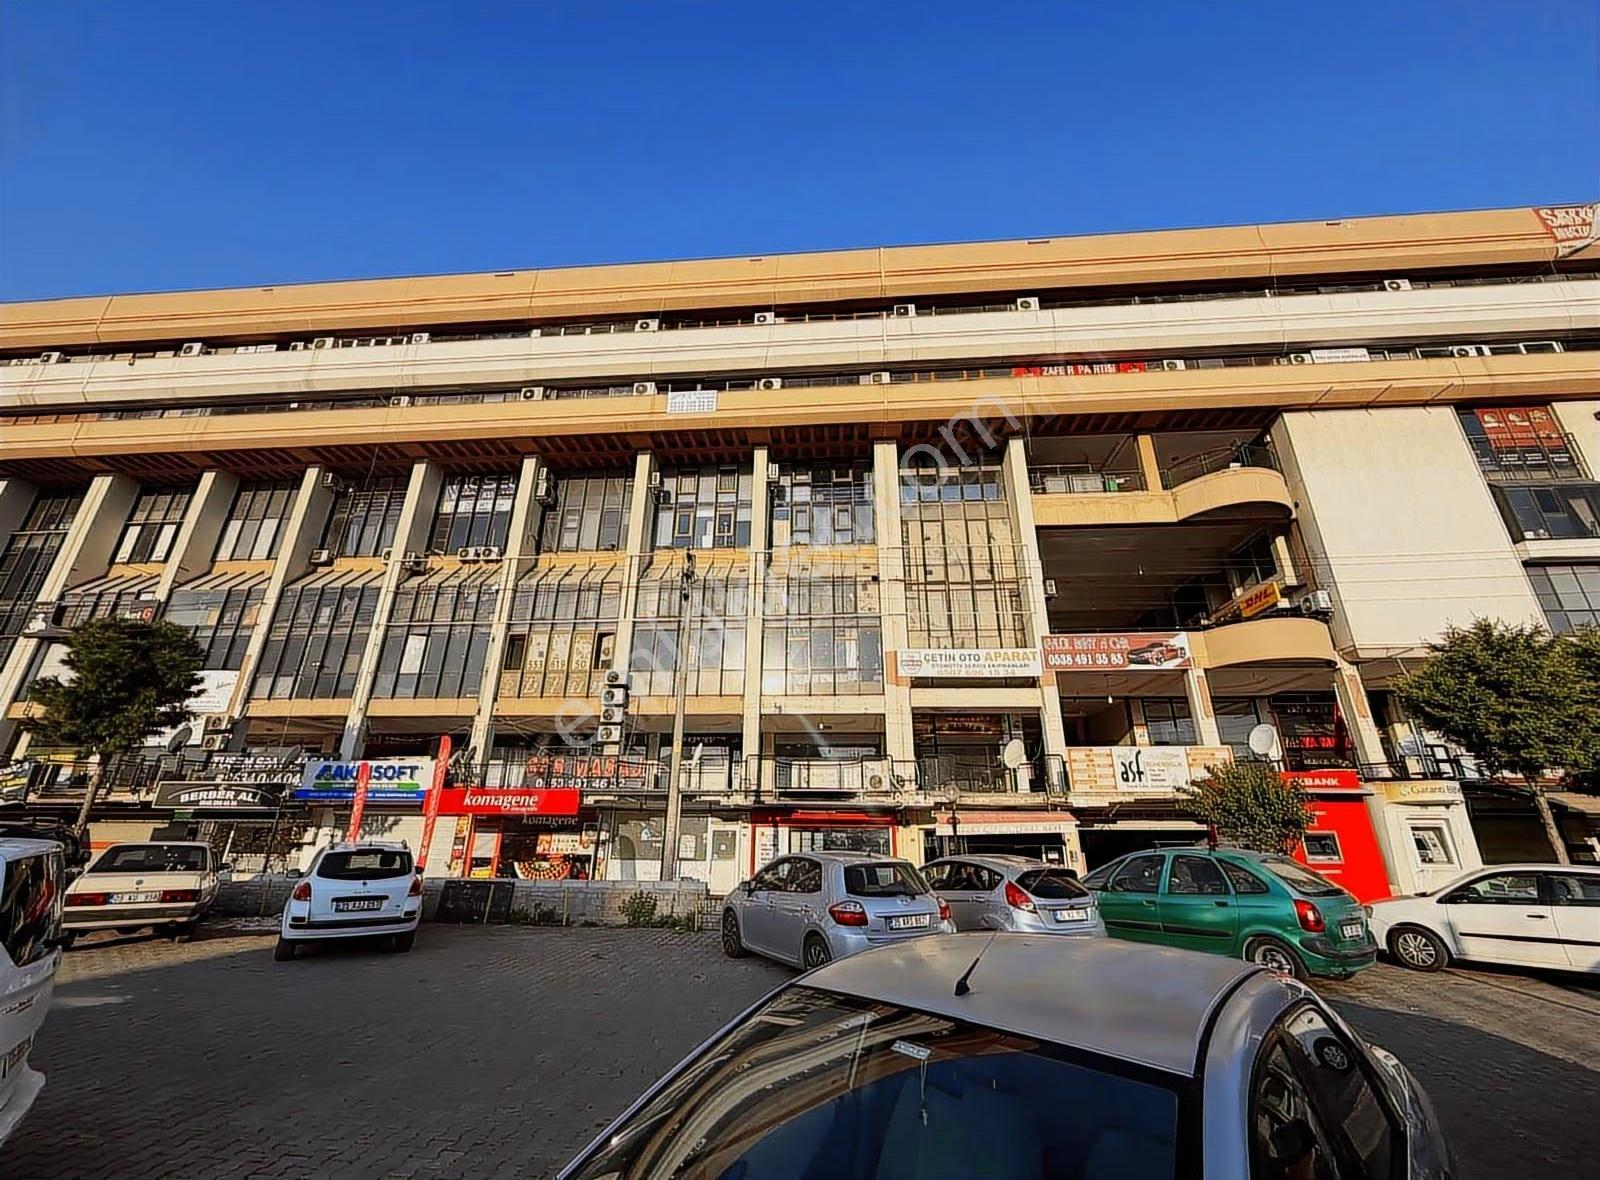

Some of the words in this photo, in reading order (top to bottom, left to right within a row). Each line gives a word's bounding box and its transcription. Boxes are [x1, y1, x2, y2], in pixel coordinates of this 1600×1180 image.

[1042, 366, 1074, 377] ZAFER
[923, 651, 956, 663] ÇETİN
[959, 653, 981, 662] OTO
[984, 651, 1038, 661] APARAT
[332, 764, 420, 780] AKSOFT
[1410, 784, 1446, 794] Garanti
[180, 790, 235, 802] BERBER
[463, 790, 539, 811] komagene
